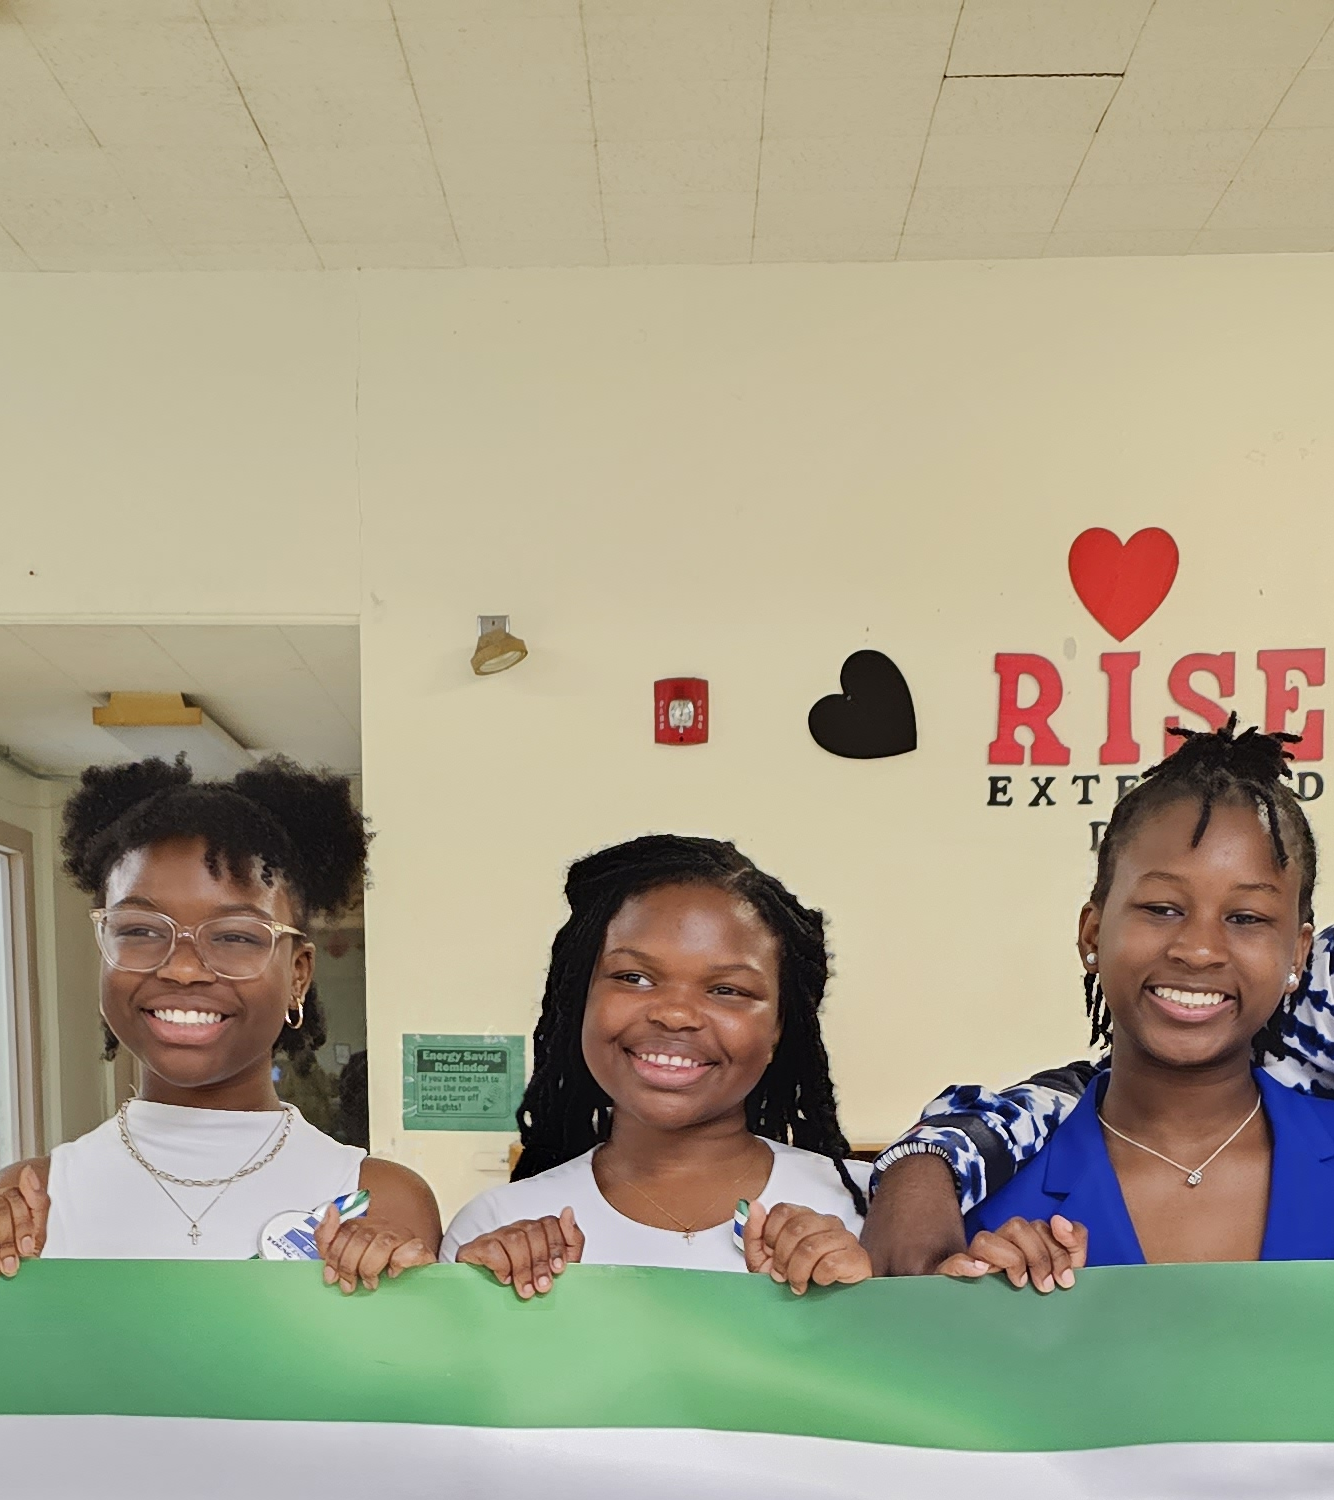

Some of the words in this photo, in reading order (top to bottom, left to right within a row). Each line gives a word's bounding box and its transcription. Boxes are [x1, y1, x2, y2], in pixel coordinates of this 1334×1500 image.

[988, 648, 1326, 767] RISE
[422, 1050, 462, 1063] Energy
[463, 1050, 502, 1063] Saving
[434, 1062, 489, 1072] Reminder
[428, 1075, 443, 1084] you
[458, 1075, 473, 1083] the
[473, 1075, 489, 1083] last
[490, 1075, 499, 1083] to
[421, 1083, 442, 1091] leave
[443, 1084, 456, 1092] the
[421, 1093, 448, 1102] please
[448, 1093, 466, 1102] turn
[467, 1093, 479, 1102] off
[421, 1103, 434, 1111] the
[435, 1103, 462, 1113] lights!
